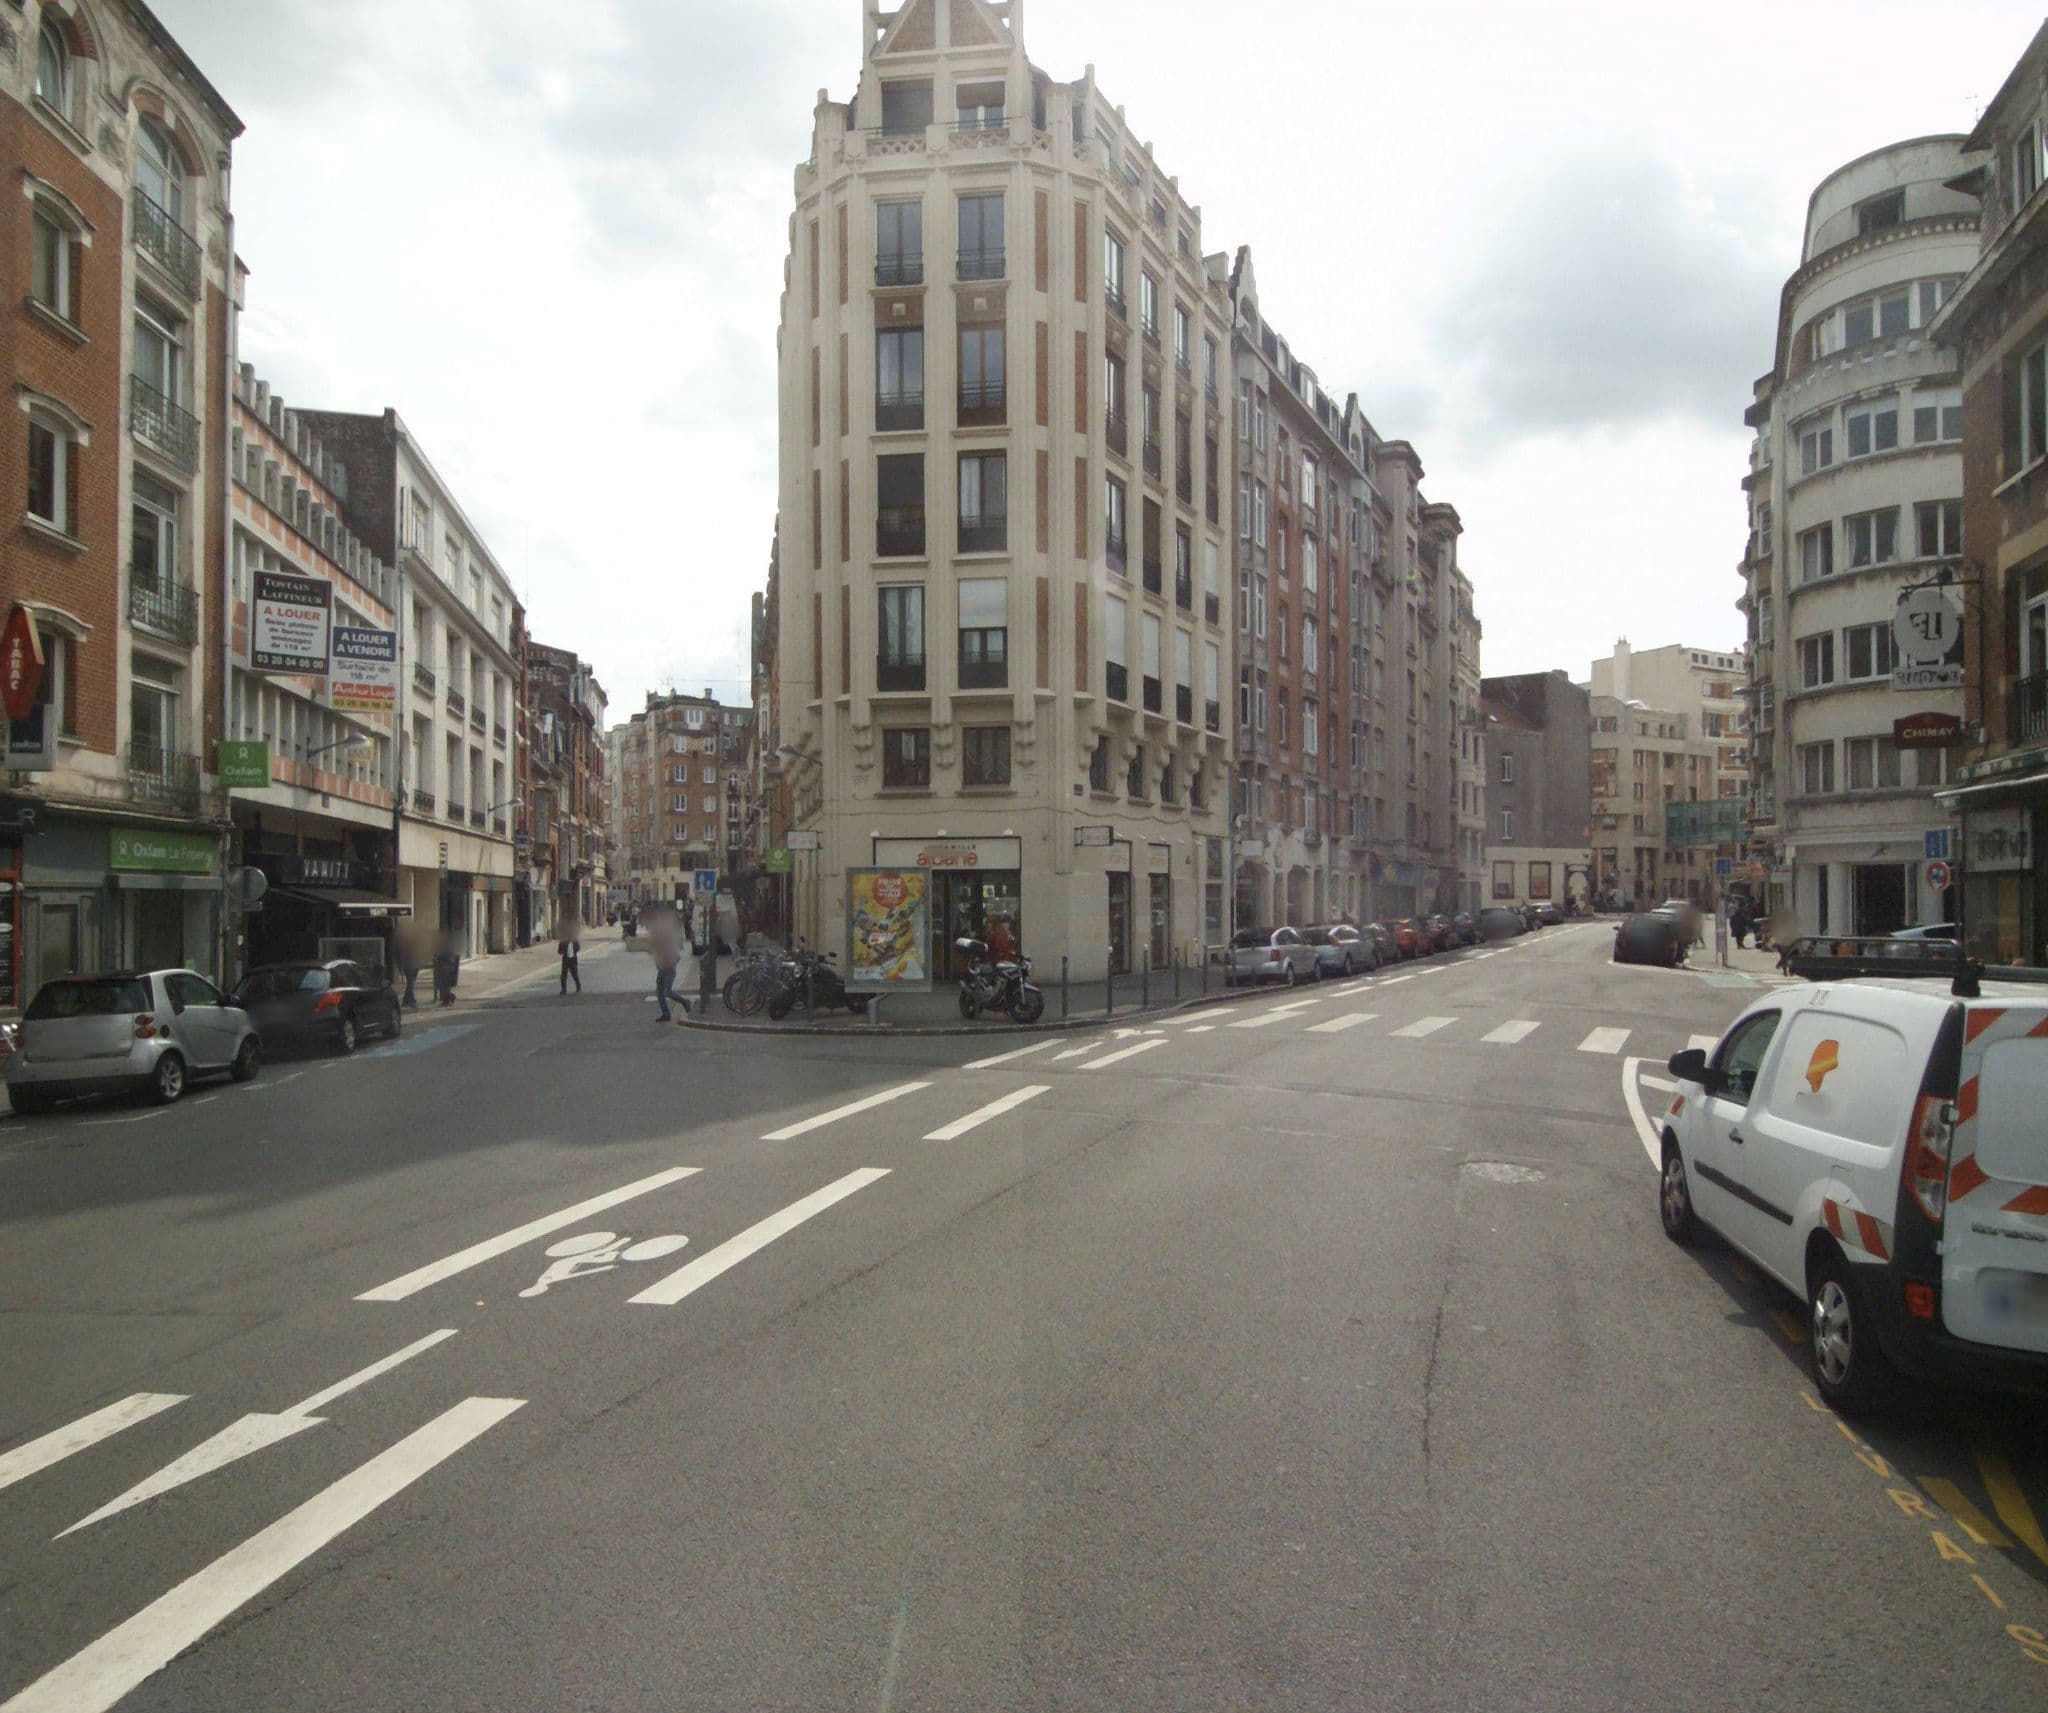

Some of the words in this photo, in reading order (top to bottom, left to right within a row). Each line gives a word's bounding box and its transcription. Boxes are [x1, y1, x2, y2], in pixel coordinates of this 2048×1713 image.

[264, 606, 272, 615] A
[278, 608, 321, 621] LOUER
[341, 631, 350, 641] A
[352, 633, 389, 645] LOUER
[336, 643, 345, 653] A
[347, 645, 392, 657] VENDRE
[10, 637, 23, 691] TABAC
[257, 654, 269, 664] 03
[1902, 726, 1955, 739] CHIMAY
[224, 765, 263, 777] Oxfam
[133, 842, 166, 858] Oxfam
[304, 858, 350, 879] VANITY
